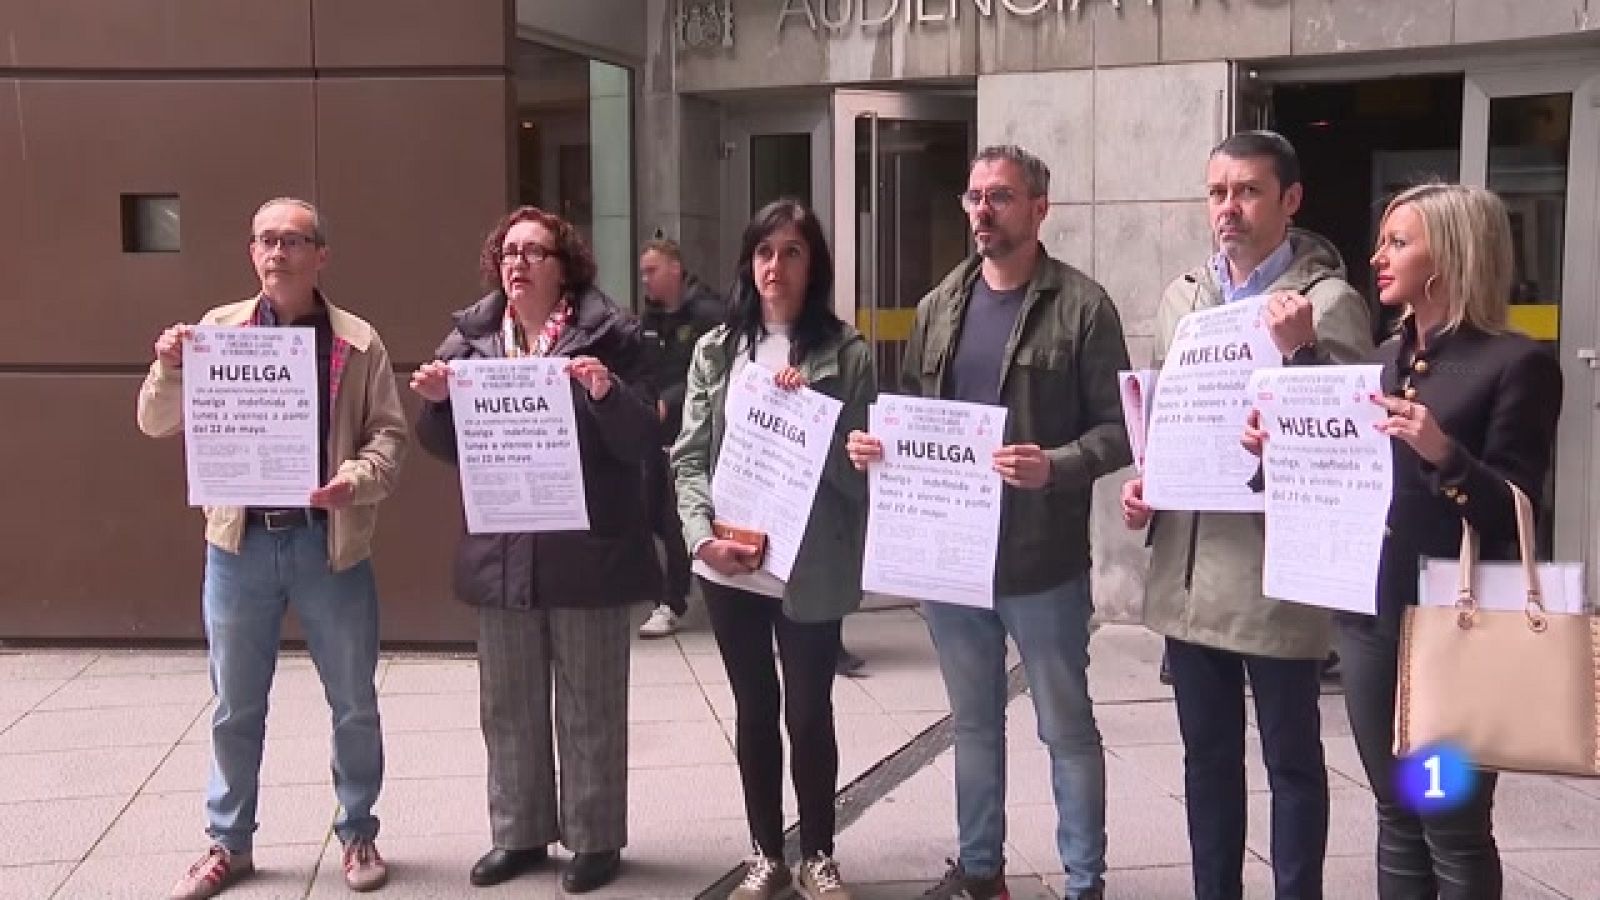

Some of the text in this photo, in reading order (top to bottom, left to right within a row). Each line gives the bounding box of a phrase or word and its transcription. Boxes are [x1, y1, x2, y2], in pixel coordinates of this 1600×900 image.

[1178, 342, 1253, 366] HUELGA
[209, 364, 291, 382] HUELGA
[1197, 381, 1246, 393] indefinida
[192, 398, 310, 408] Huelga indefinida de
[474, 396, 551, 414] HUELGA
[192, 412, 218, 421] lunes
[233, 412, 268, 421] viernes
[282, 412, 310, 422] partir
[192, 425, 208, 434] del
[224, 425, 236, 434] de
[464, 426, 569, 439] Huelga indefinida de
[747, 406, 806, 449] HUELGA
[1277, 415, 1360, 439] HUELGA
[464, 441, 489, 450] lunes
[501, 441, 533, 450] viernes
[545, 440, 571, 450] partir
[465, 454, 480, 463] del
[494, 454, 506, 463] de
[897, 439, 976, 466] HUELGA
[1310, 458, 1360, 471] indefinida
[922, 478, 969, 492] indefinida
